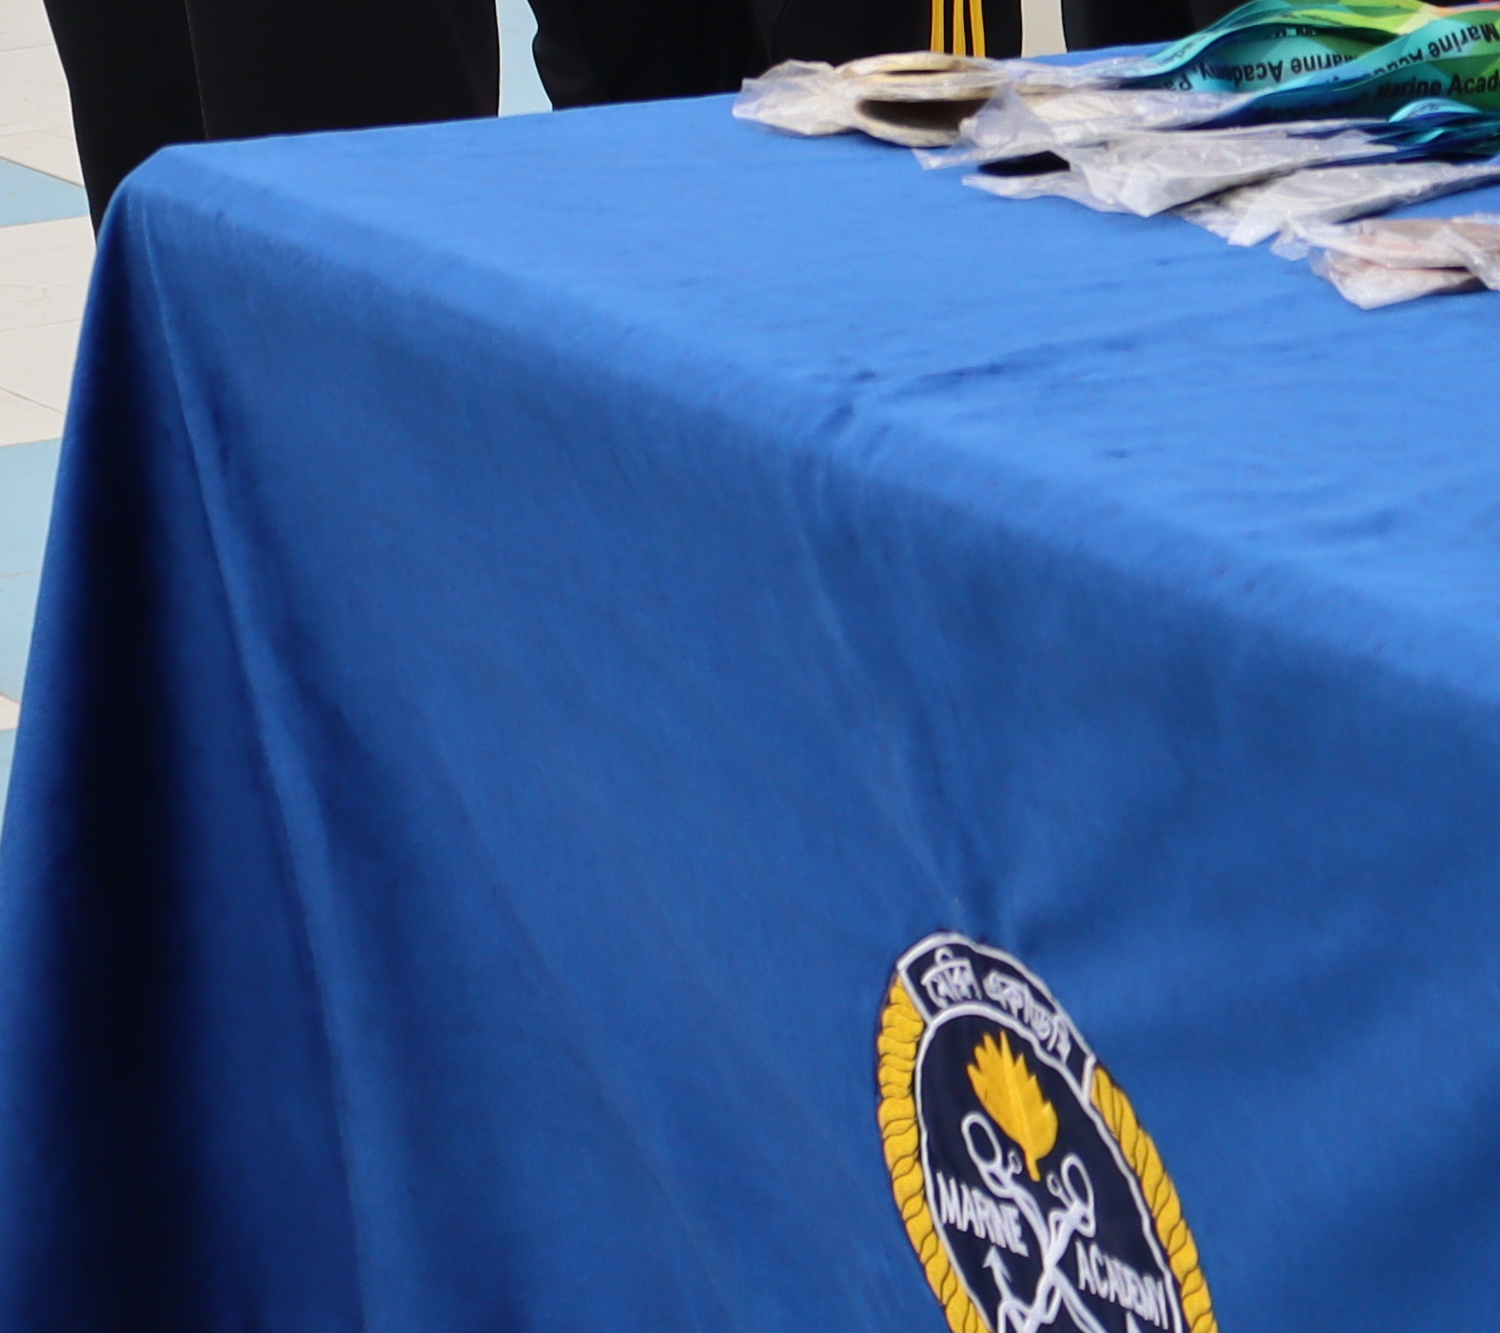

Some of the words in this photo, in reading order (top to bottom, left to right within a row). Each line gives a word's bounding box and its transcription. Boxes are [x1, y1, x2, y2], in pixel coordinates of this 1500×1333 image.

[1427, 22, 1497, 57] Marine
[936, 1171, 1029, 1259] MARINE
[1074, 1239, 1169, 1331] ACADEMY
